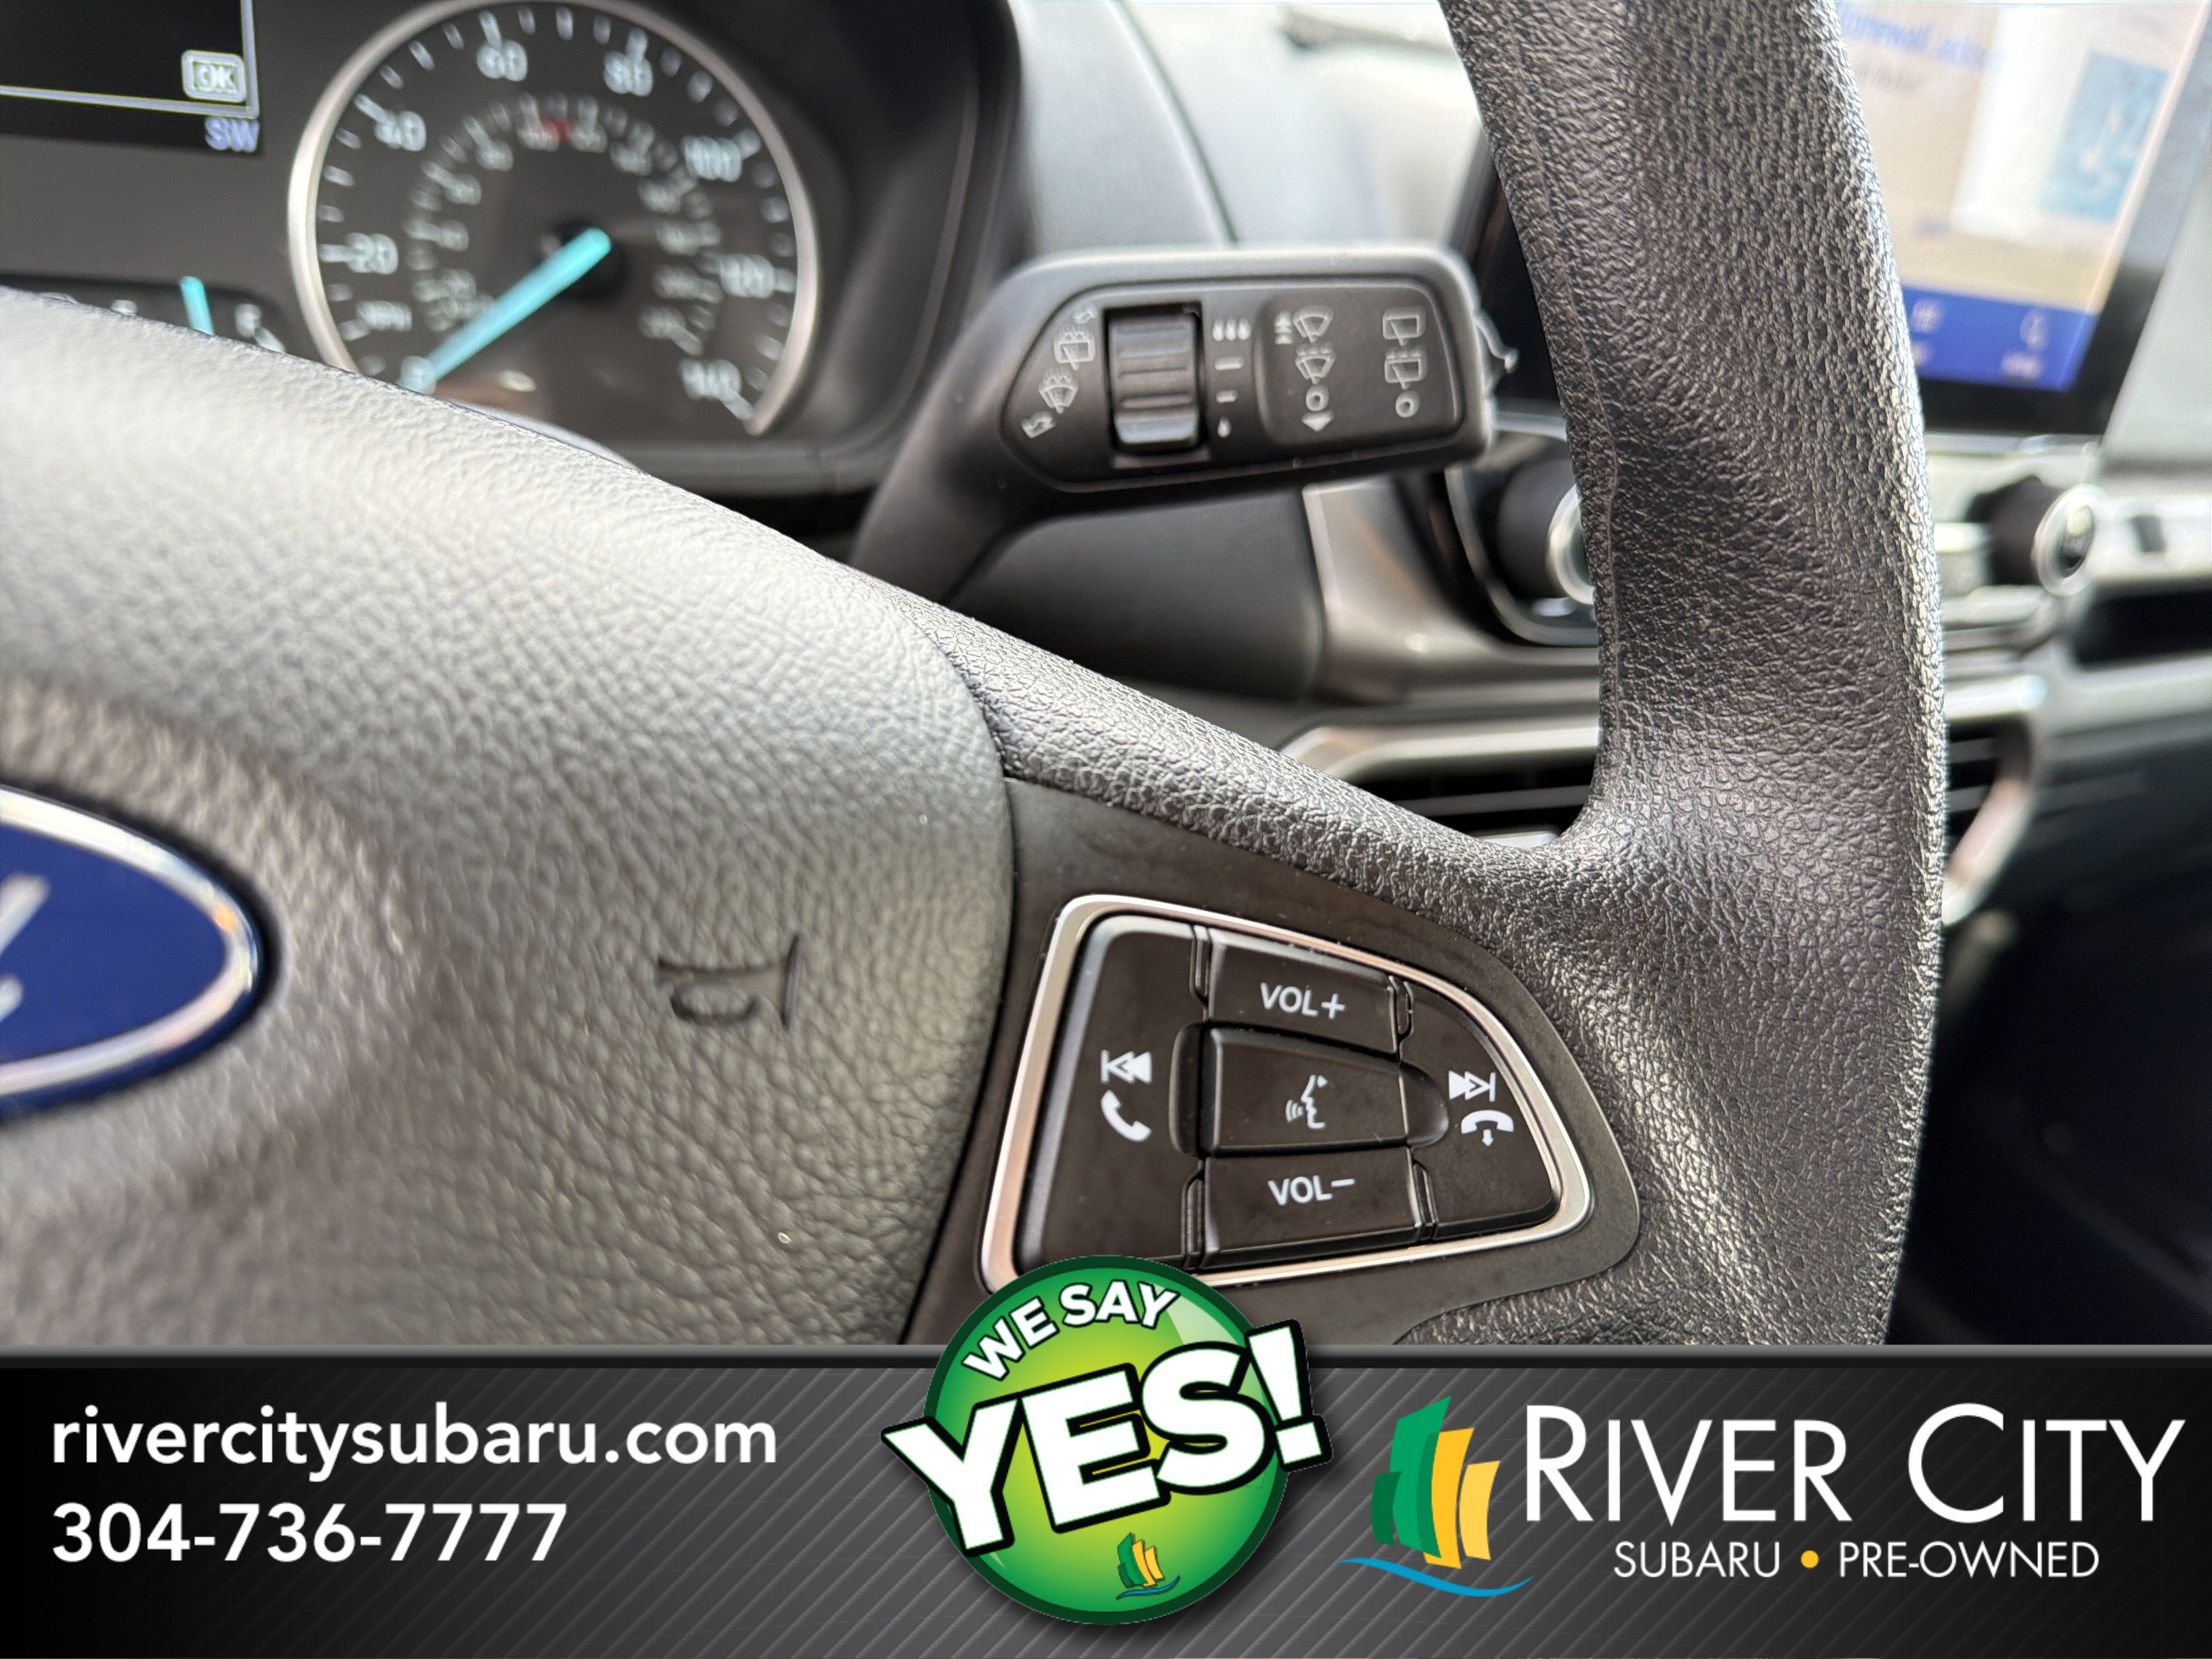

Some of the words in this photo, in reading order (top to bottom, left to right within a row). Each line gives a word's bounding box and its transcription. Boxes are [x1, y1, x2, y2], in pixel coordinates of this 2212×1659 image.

[197, 64, 236, 88] OK
[477, 40, 528, 81] 60
[375, 110, 427, 151] 40
[346, 232, 398, 275] 20
